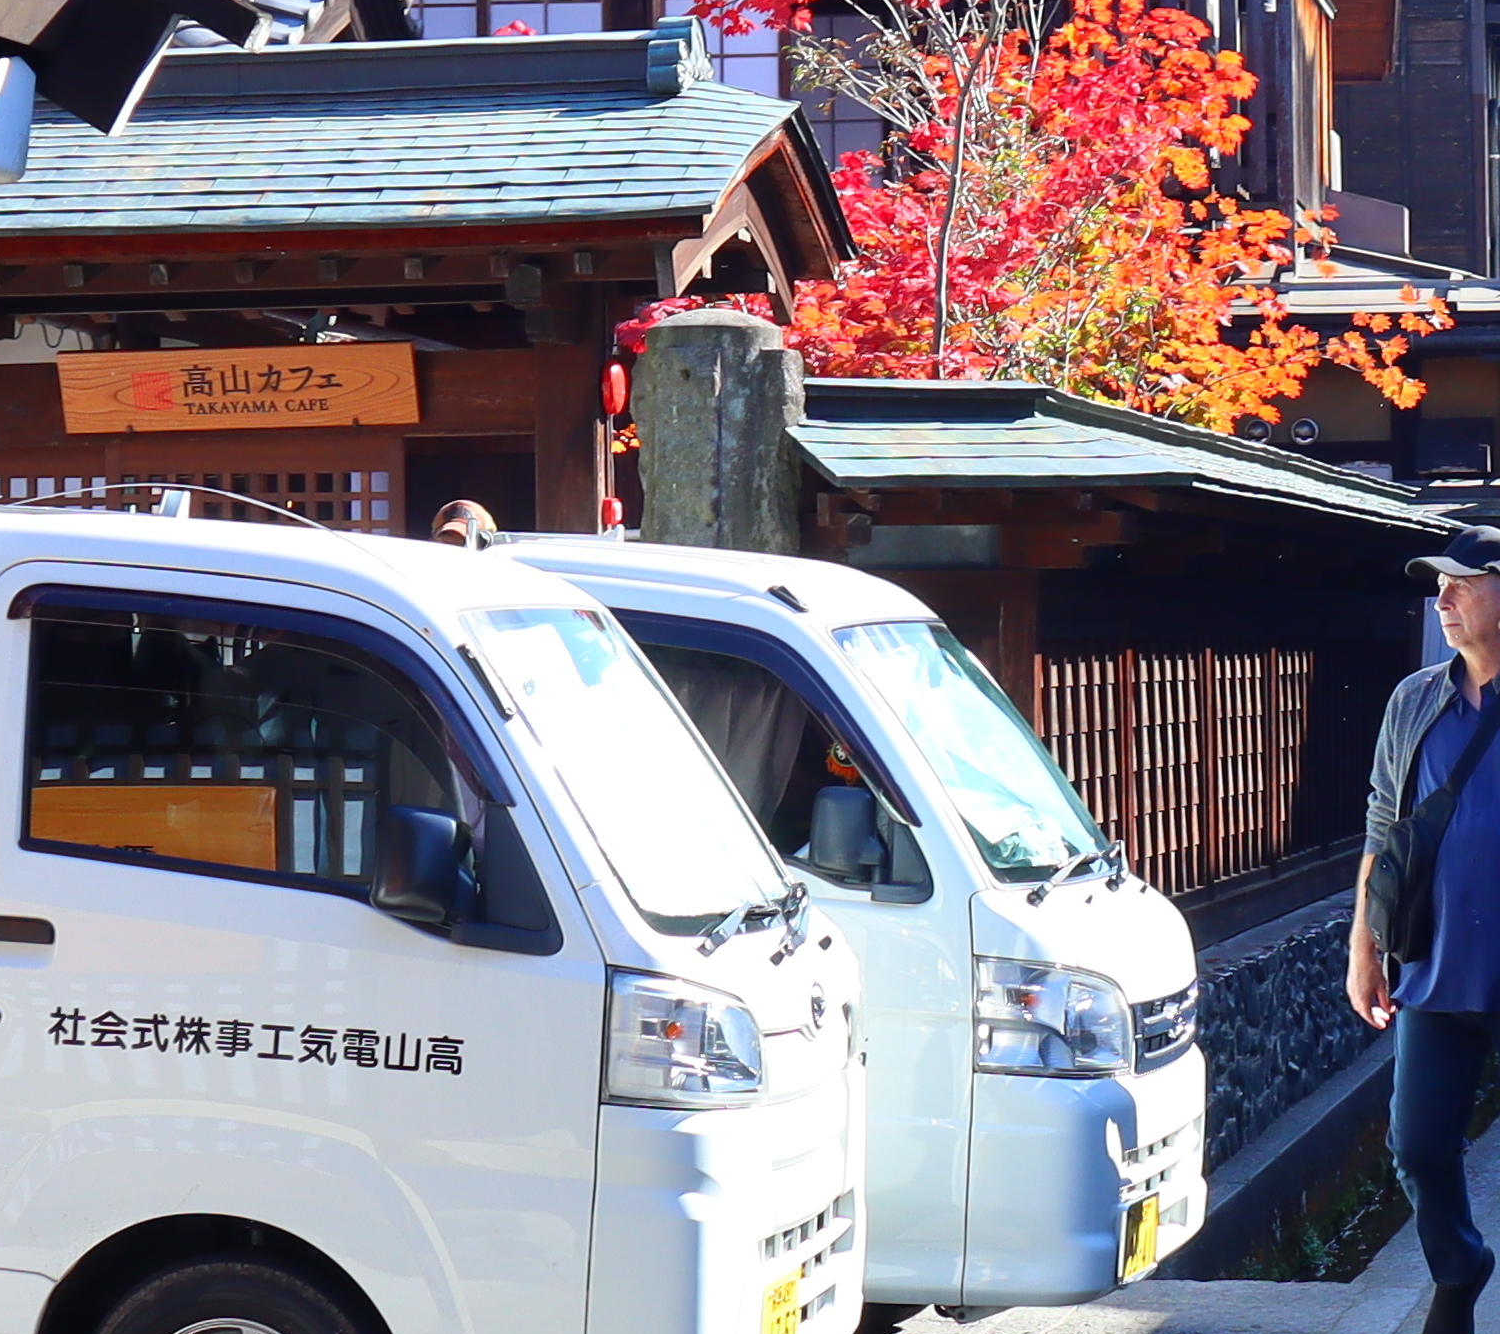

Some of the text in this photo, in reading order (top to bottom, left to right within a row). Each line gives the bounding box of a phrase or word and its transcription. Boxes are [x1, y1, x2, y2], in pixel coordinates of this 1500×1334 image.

[180, 363, 344, 398] 高山カフェ
[183, 398, 329, 415] TAKAYAMA CAFE
